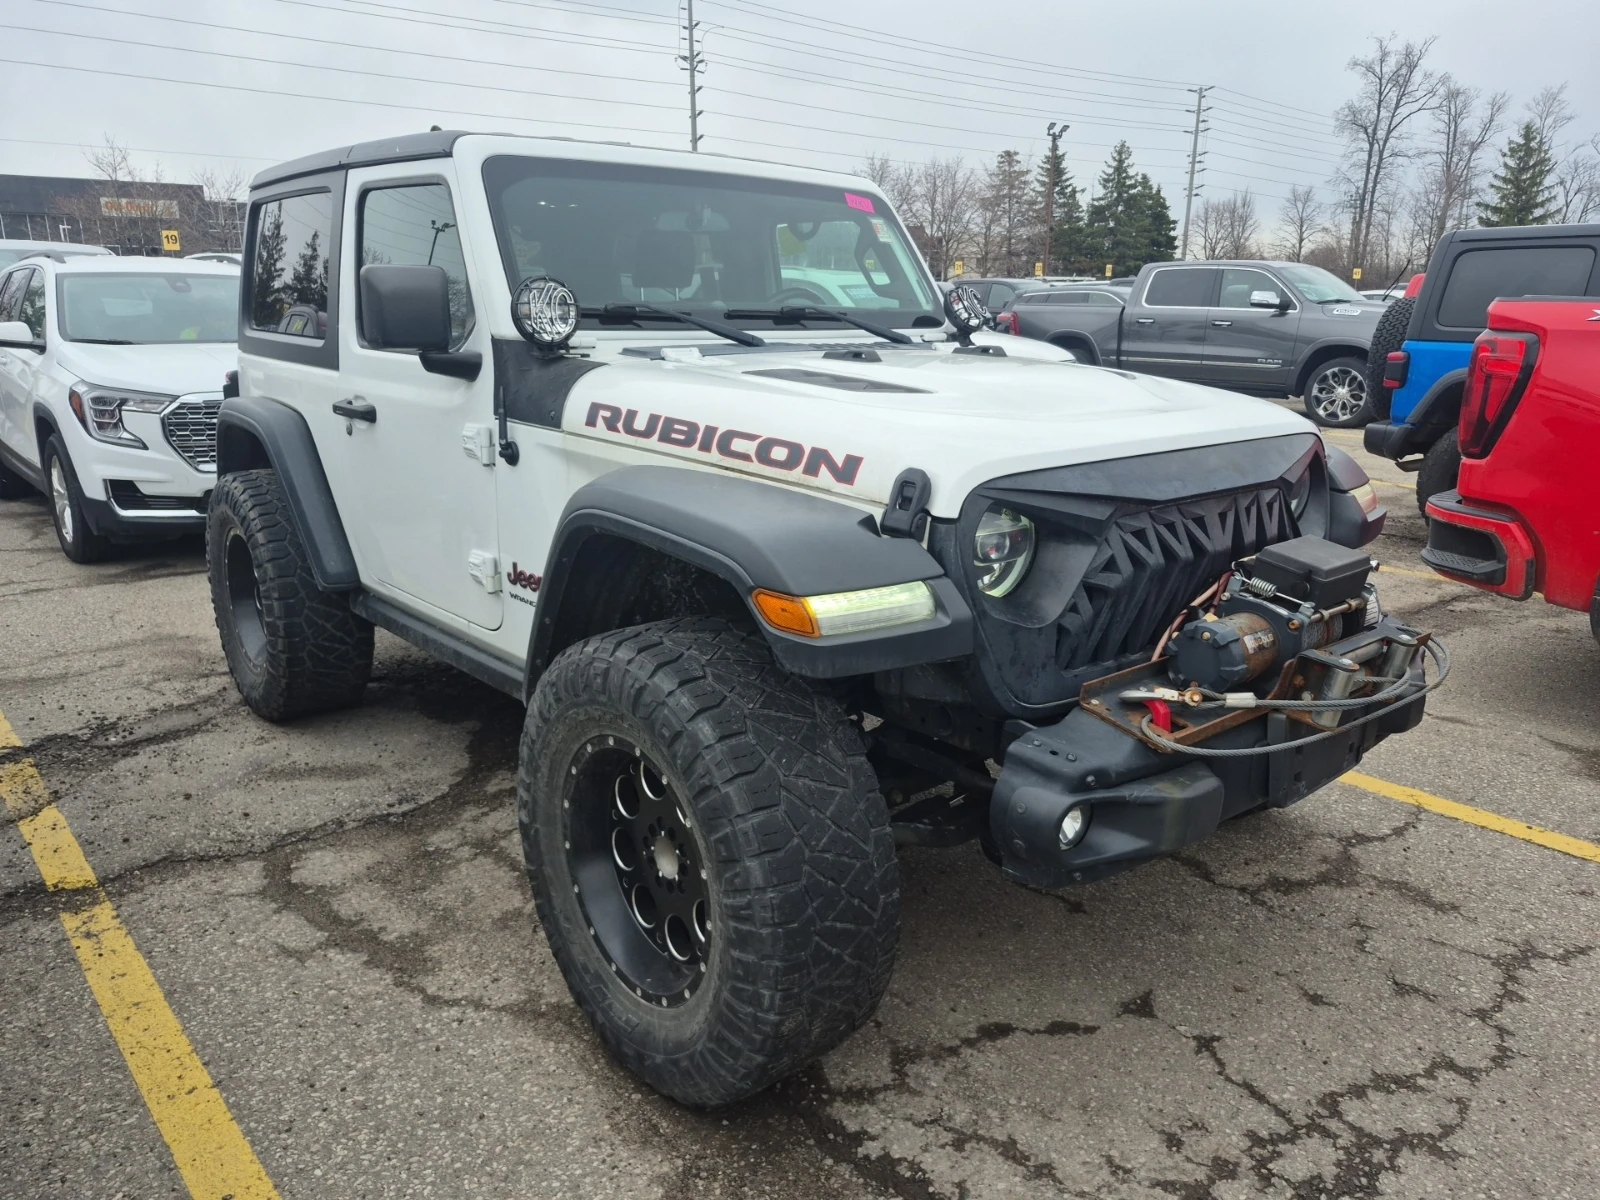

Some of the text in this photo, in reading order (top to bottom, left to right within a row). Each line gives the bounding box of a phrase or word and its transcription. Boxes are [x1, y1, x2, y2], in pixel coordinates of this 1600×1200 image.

[164, 234, 178, 245] 19
[529, 282, 576, 338] KC
[585, 401, 864, 487] RUBICON
